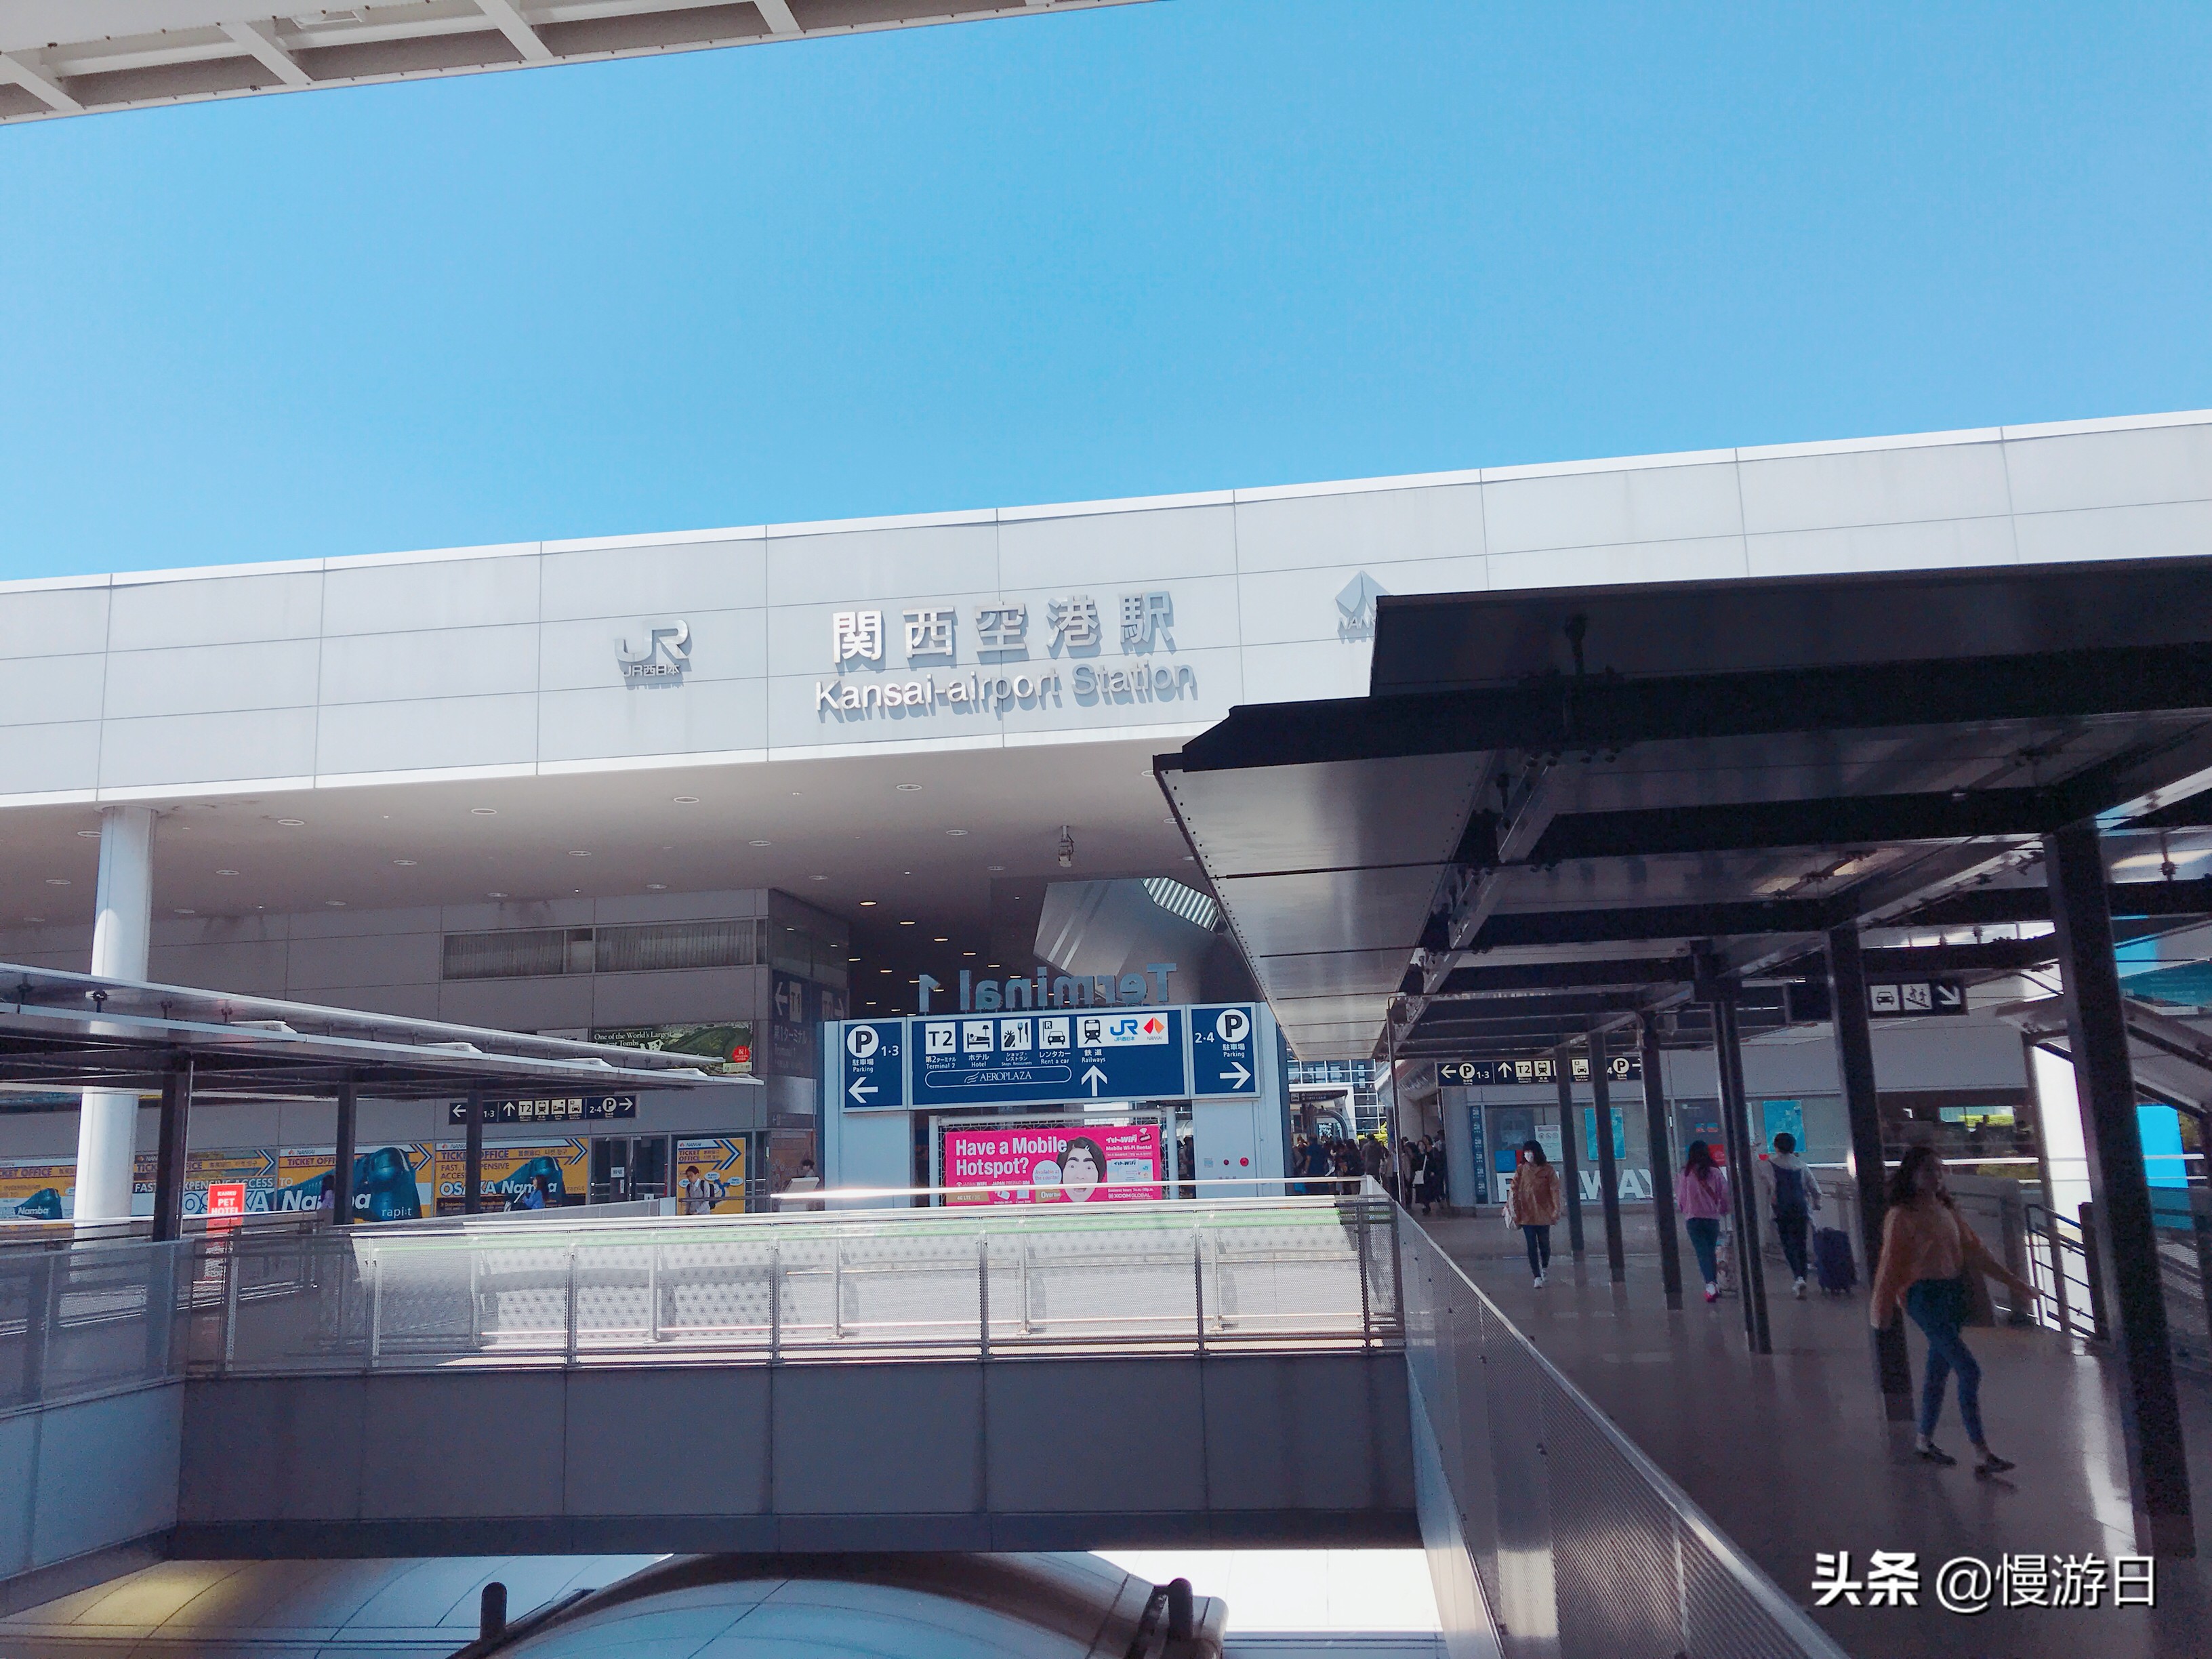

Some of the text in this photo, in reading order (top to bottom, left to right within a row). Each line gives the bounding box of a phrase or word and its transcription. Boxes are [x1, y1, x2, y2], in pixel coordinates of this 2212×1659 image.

[833, 590, 1171, 663] 関西空港駅
[614, 619, 689, 663] JR
[623, 664, 680, 677] JR西日本
[815, 659, 1195, 710] Kansai-airport Station
[1110, 1019, 1138, 1036] JR
[1225, 1015, 1242, 1038] P
[651, 1031, 672, 1039] Largest
[928, 1031, 953, 1046] T2
[856, 1031, 872, 1053] P
[1517, 1065, 1530, 1074] T2
[1616, 1060, 1625, 1069] P
[979, 1071, 1032, 1082] AEROPLAZA
[1464, 1066, 1471, 1077] P
[607, 1100, 613, 1110] P
[956, 1136, 1067, 1155] Have a Mobile
[441, 1151, 466, 1160] TICK
[287, 1158, 314, 1166] TICKET
[956, 1157, 1029, 1178] Hotspot?
[20, 1168, 52, 1177] OFFICE
[280, 1177, 293, 1185] TO
[440, 1180, 557, 1195] OSKA Nama
[218, 1198, 235, 1206] PET
[18, 1206, 49, 1214] Namba
